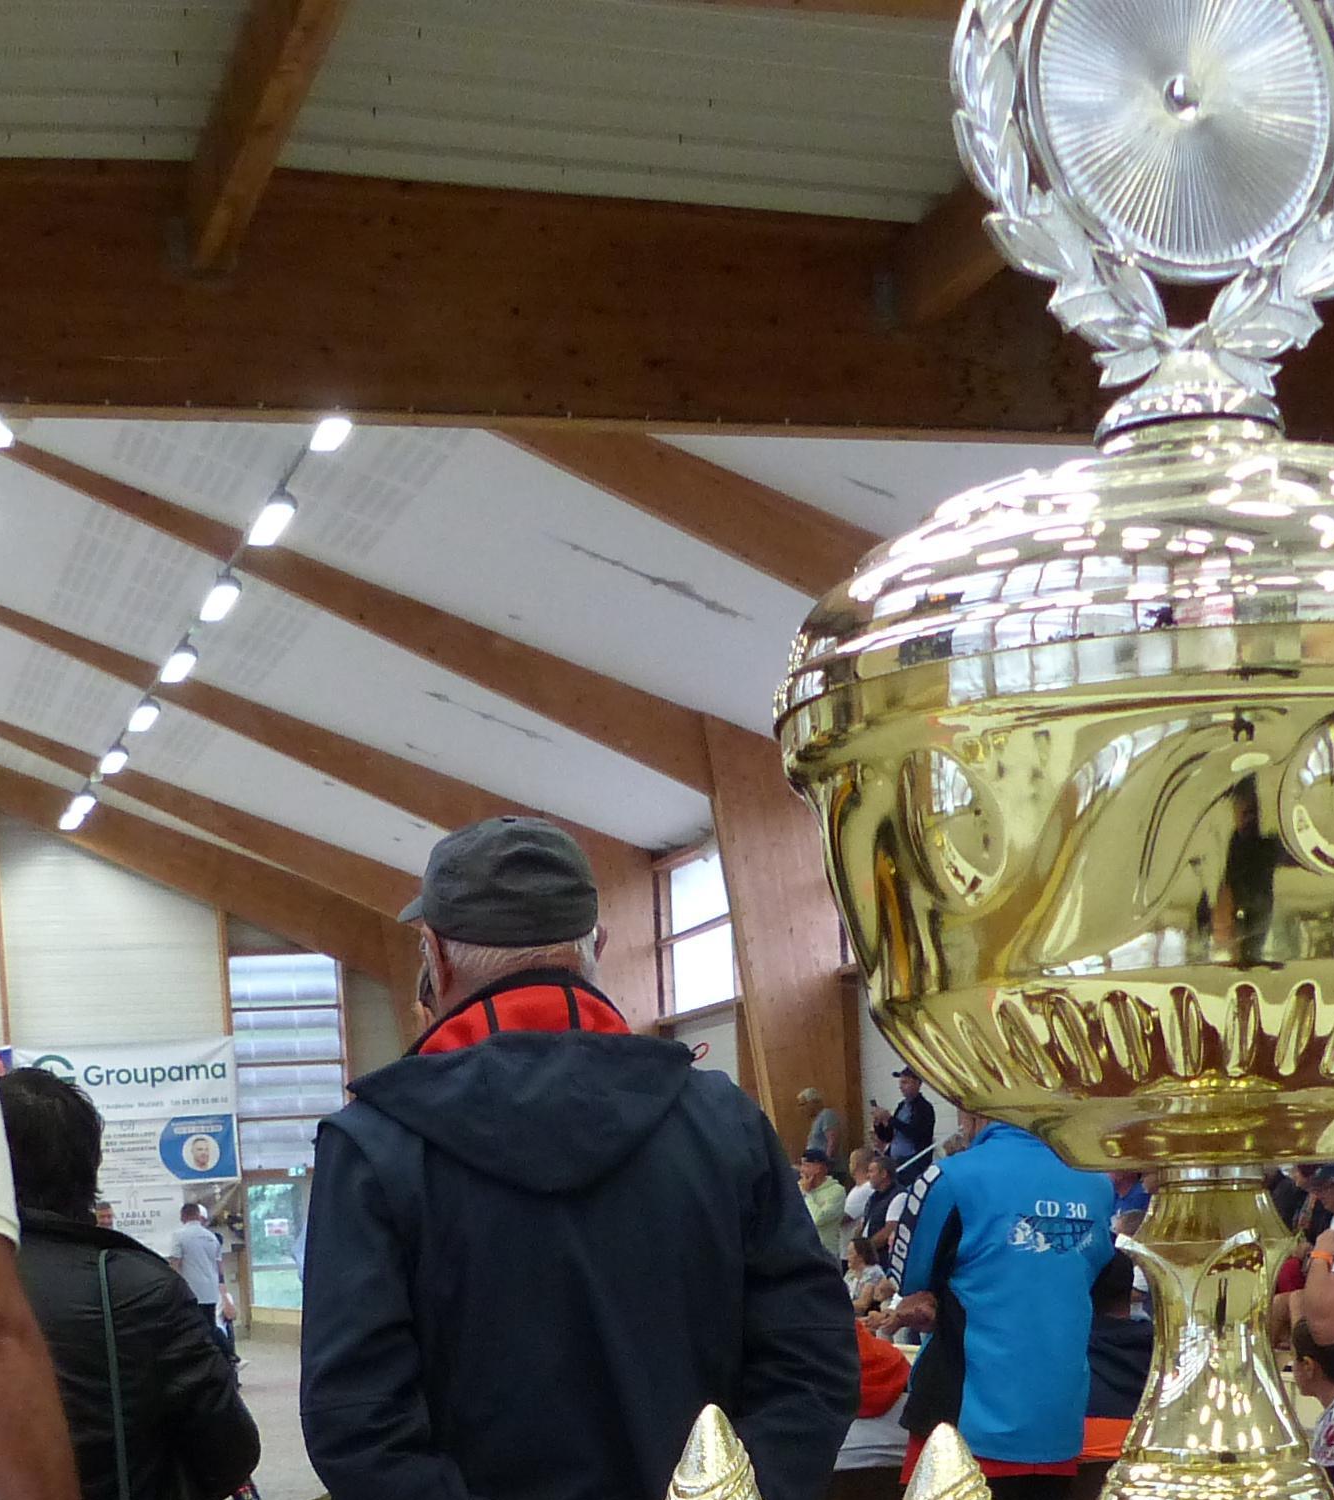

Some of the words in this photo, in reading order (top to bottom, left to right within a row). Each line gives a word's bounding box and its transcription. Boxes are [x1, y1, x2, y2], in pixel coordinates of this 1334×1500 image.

[83, 1061, 227, 1088] Groupama
[1034, 1199, 1060, 1218] CD
[1065, 1202, 1088, 1220] 30
